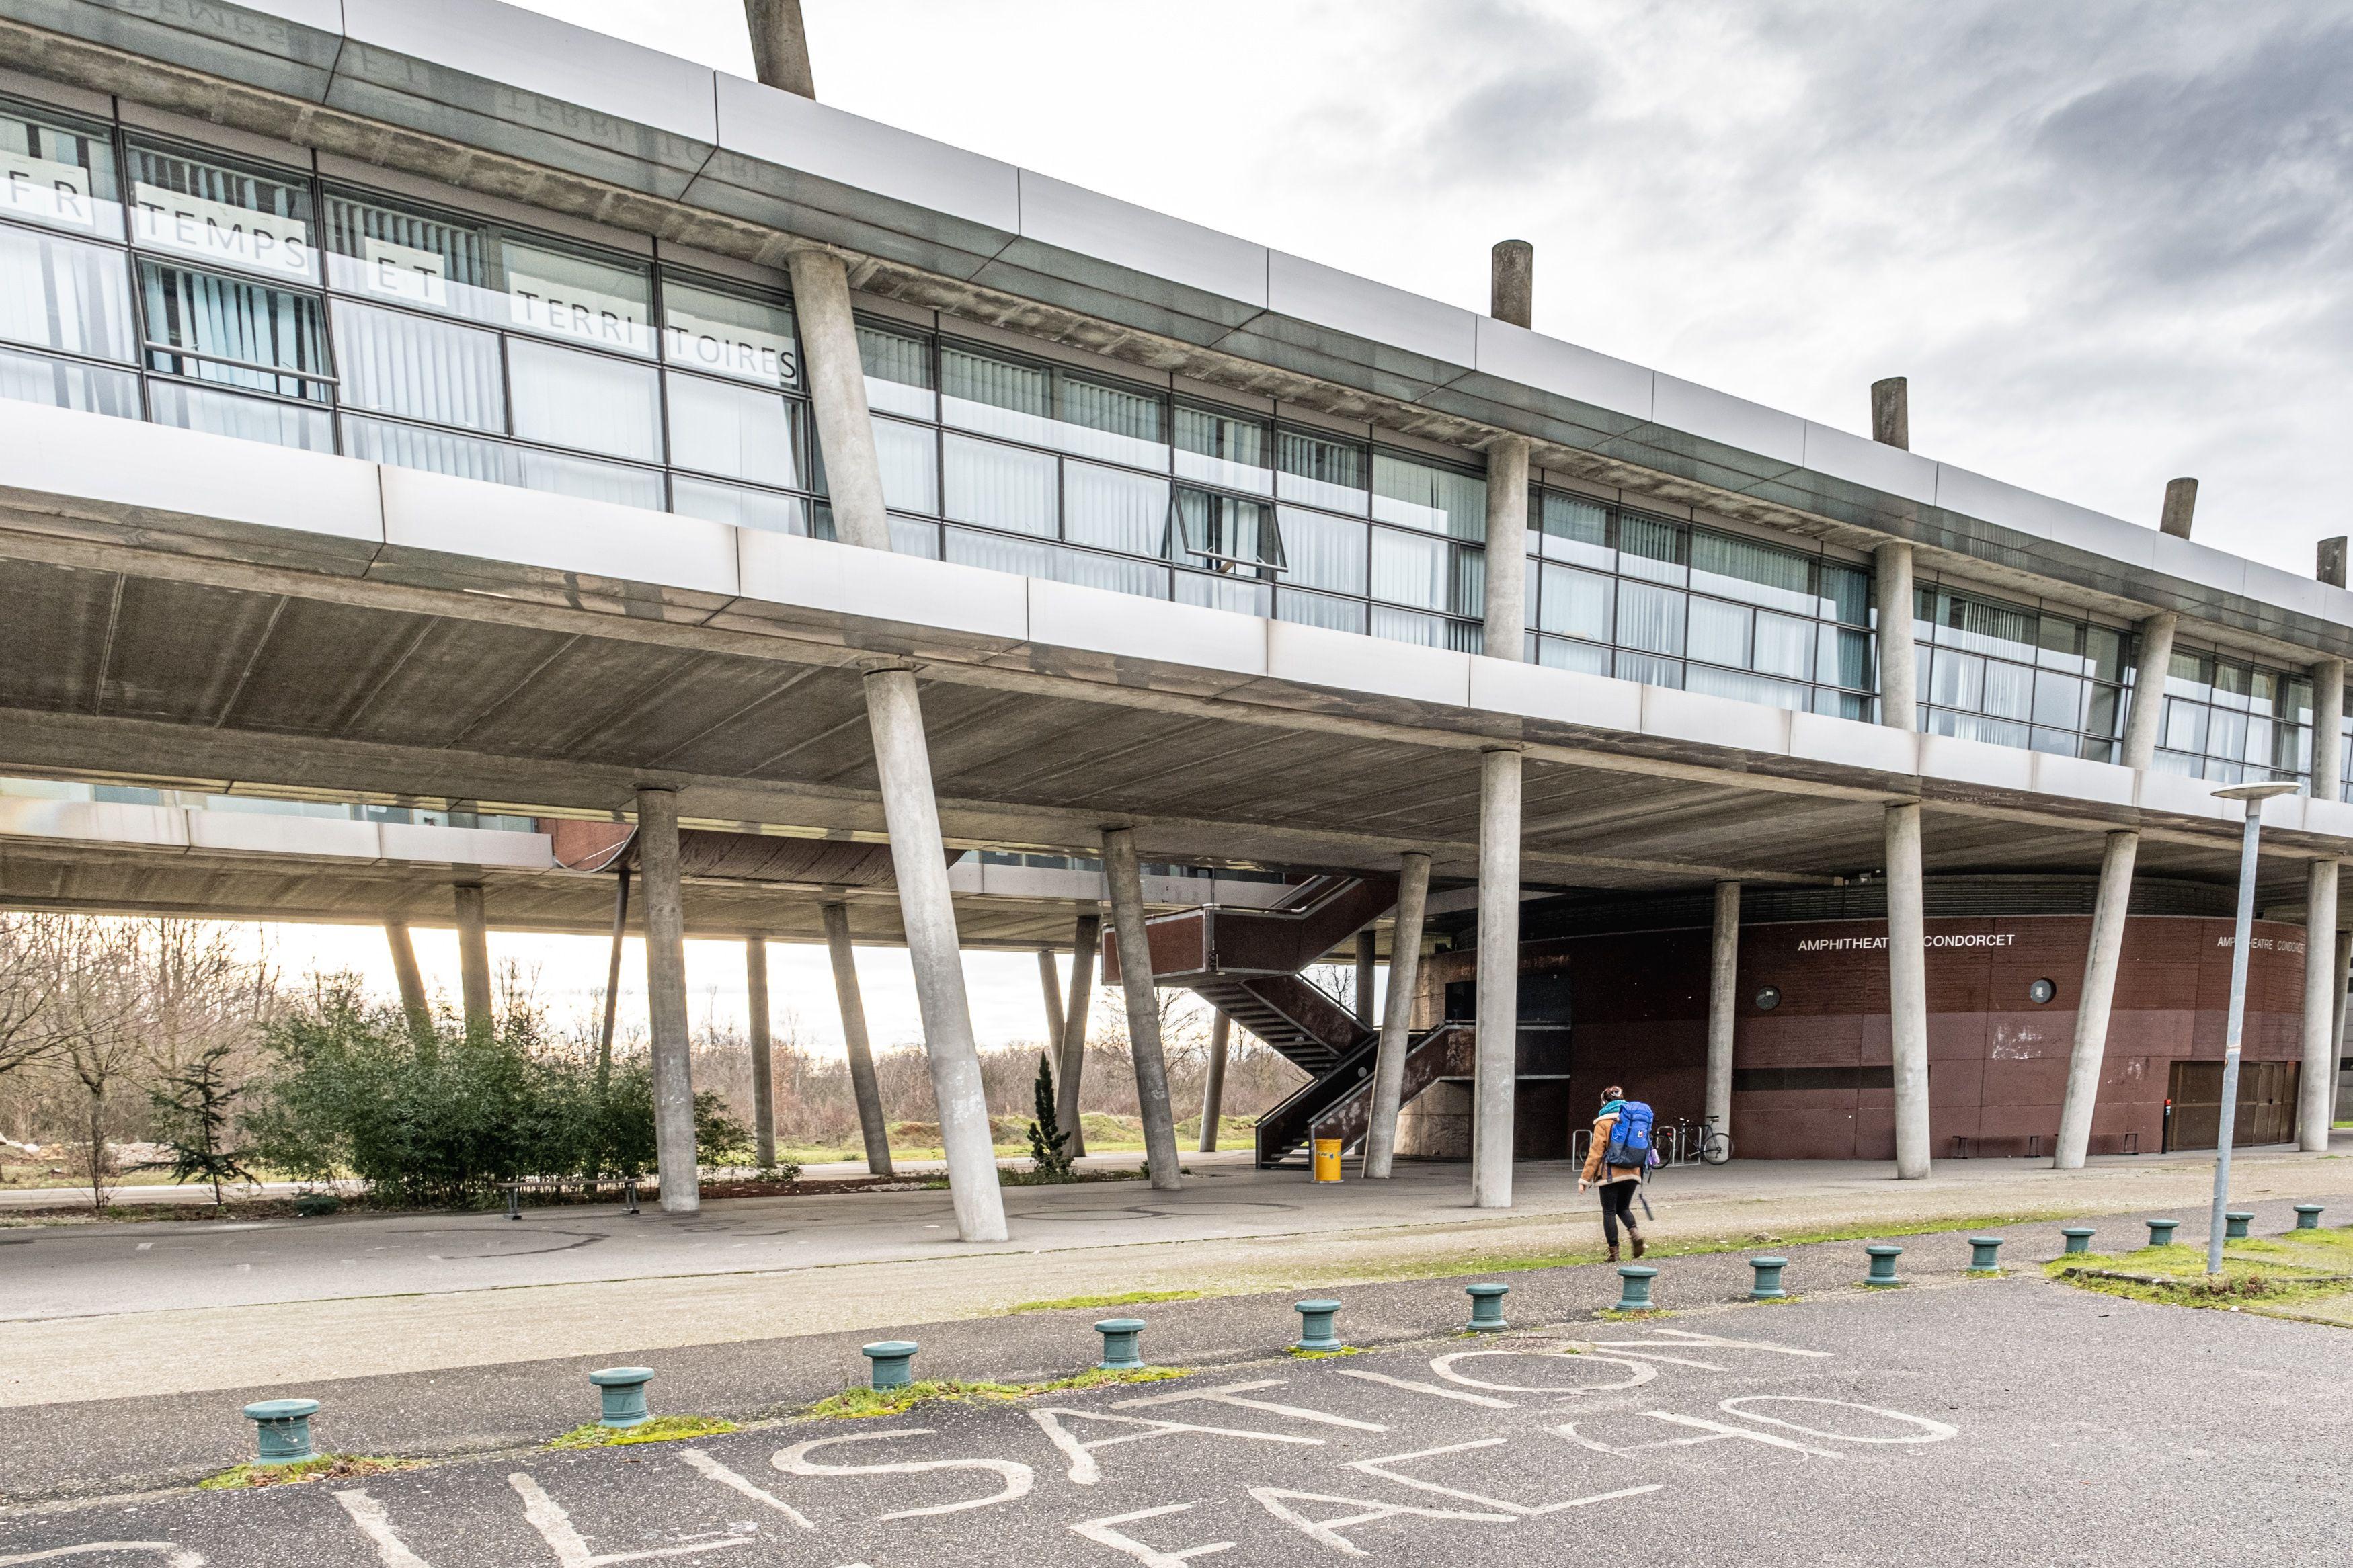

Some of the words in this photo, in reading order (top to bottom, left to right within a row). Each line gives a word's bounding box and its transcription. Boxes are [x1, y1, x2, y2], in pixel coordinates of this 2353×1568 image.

[138, 201, 306, 269] TEMPS
[378, 257, 437, 297] ET
[1797, 937, 1890, 951] AMPHITHEAT
[1923, 934, 2016, 947] CONDORCET
[0, 1328, 1835, 1568] ILISATION
